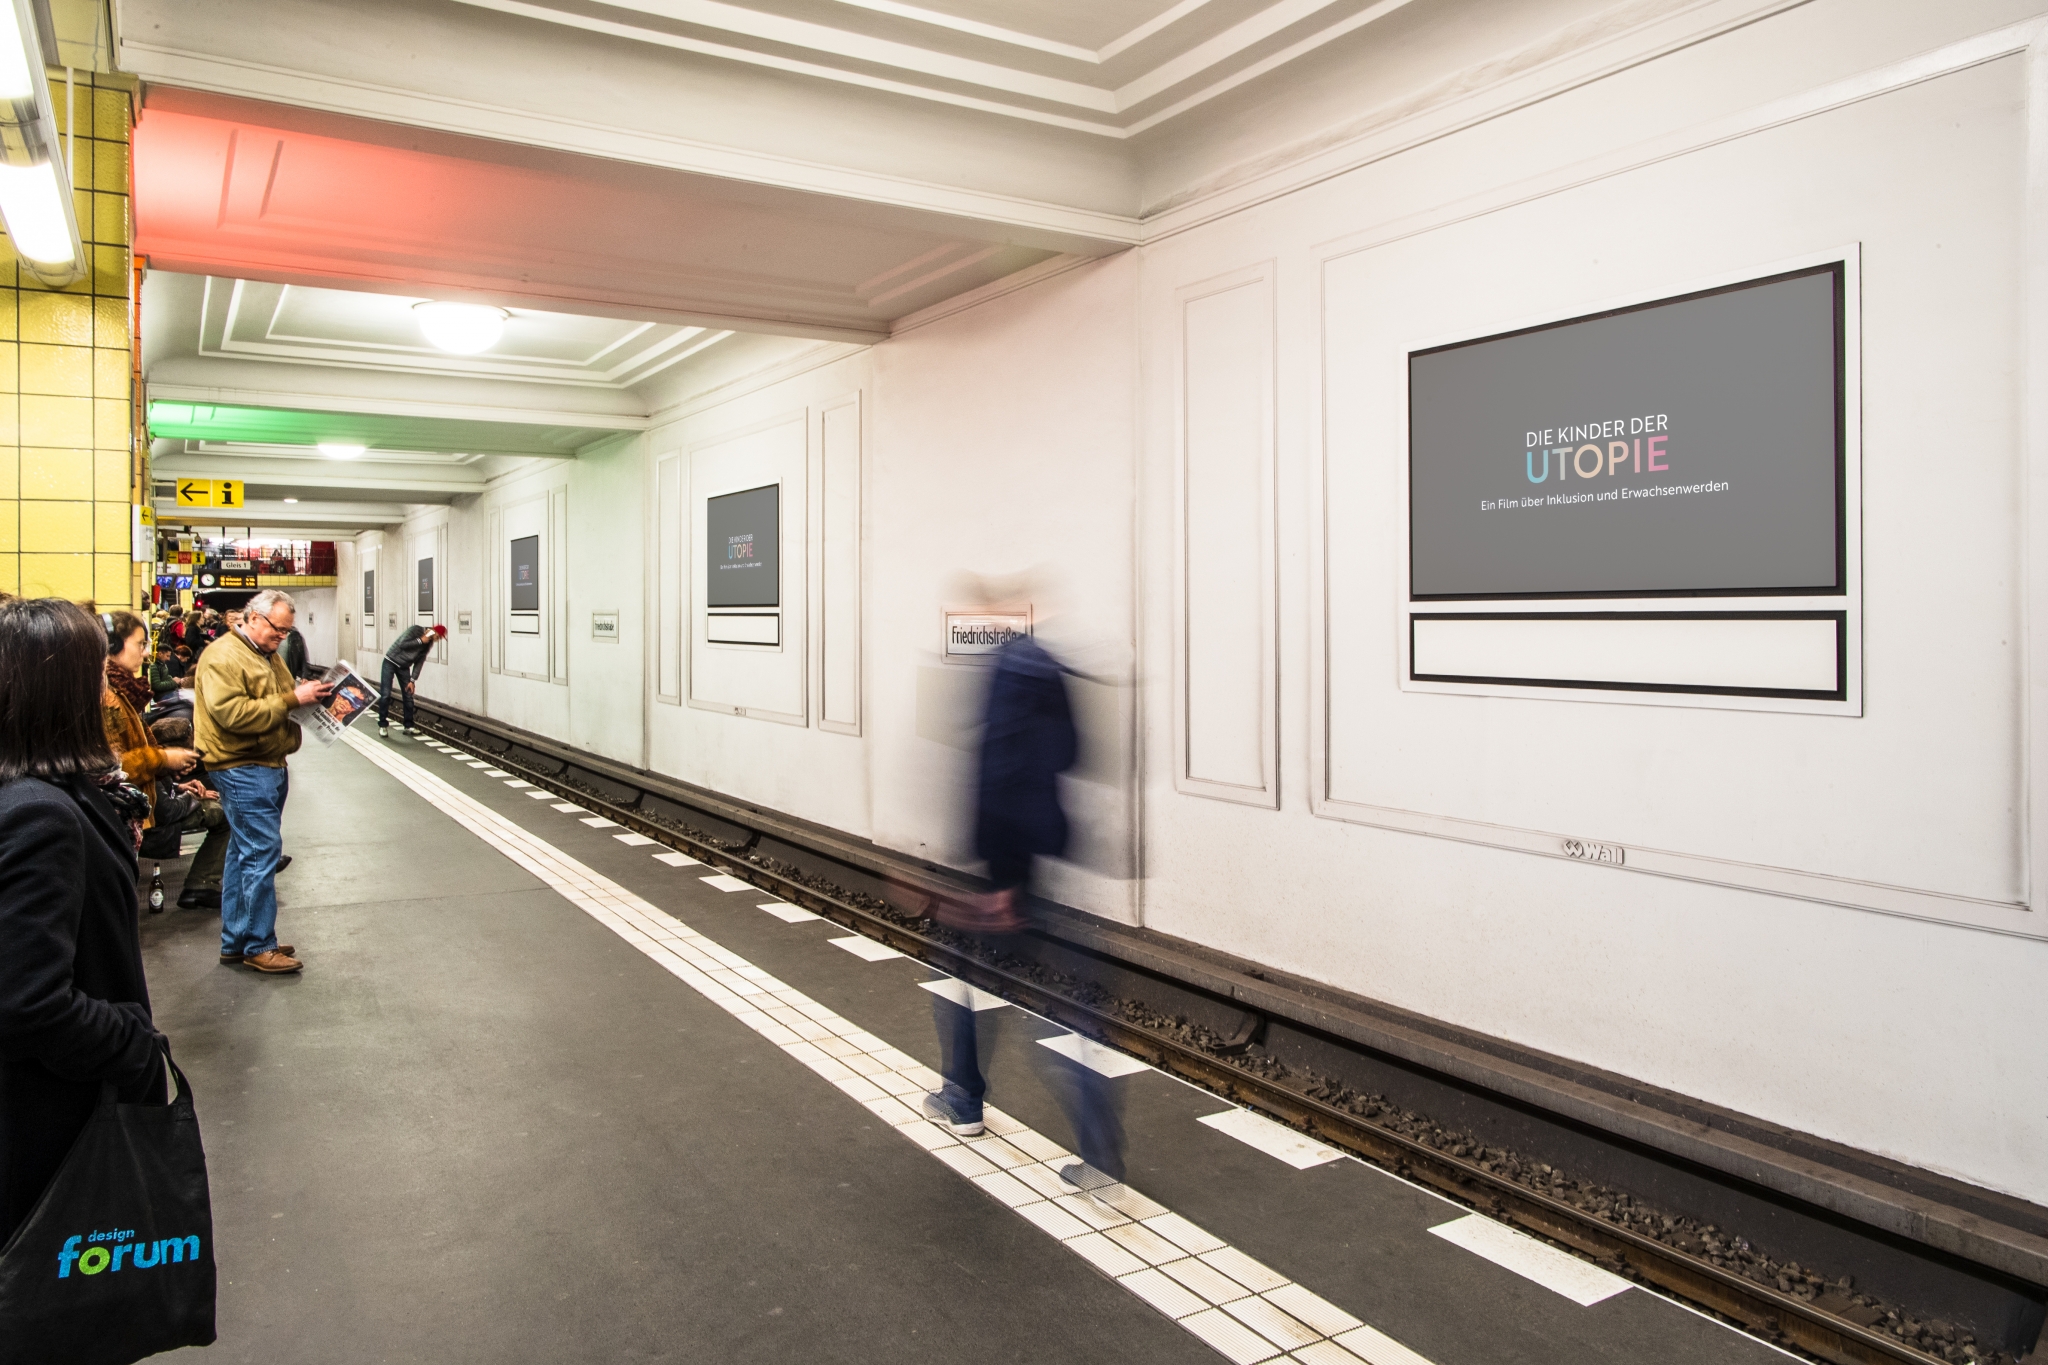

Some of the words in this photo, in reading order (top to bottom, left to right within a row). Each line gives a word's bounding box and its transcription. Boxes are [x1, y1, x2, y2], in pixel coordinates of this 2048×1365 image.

[1526, 429, 1553, 447] DIE
[1558, 420, 1625, 443] KINDER
[1630, 414, 1668, 435] DER
[1526, 435, 1669, 484] UTOPIE
[1481, 499, 1496, 511] Ein
[1498, 496, 1519, 509] Film
[1520, 494, 1544, 508] über
[1546, 491, 1594, 506] Inklusion
[1596, 488, 1618, 502] und
[1621, 480, 1729, 499] Erwachsenwerden
[728, 543, 753, 559] UTOPIE
[952, 626, 1017, 645] Friedrichstraße
[1585, 843, 1624, 865] Wall
[88, 1228, 135, 1242] design
[58, 1235, 200, 1278] forum
